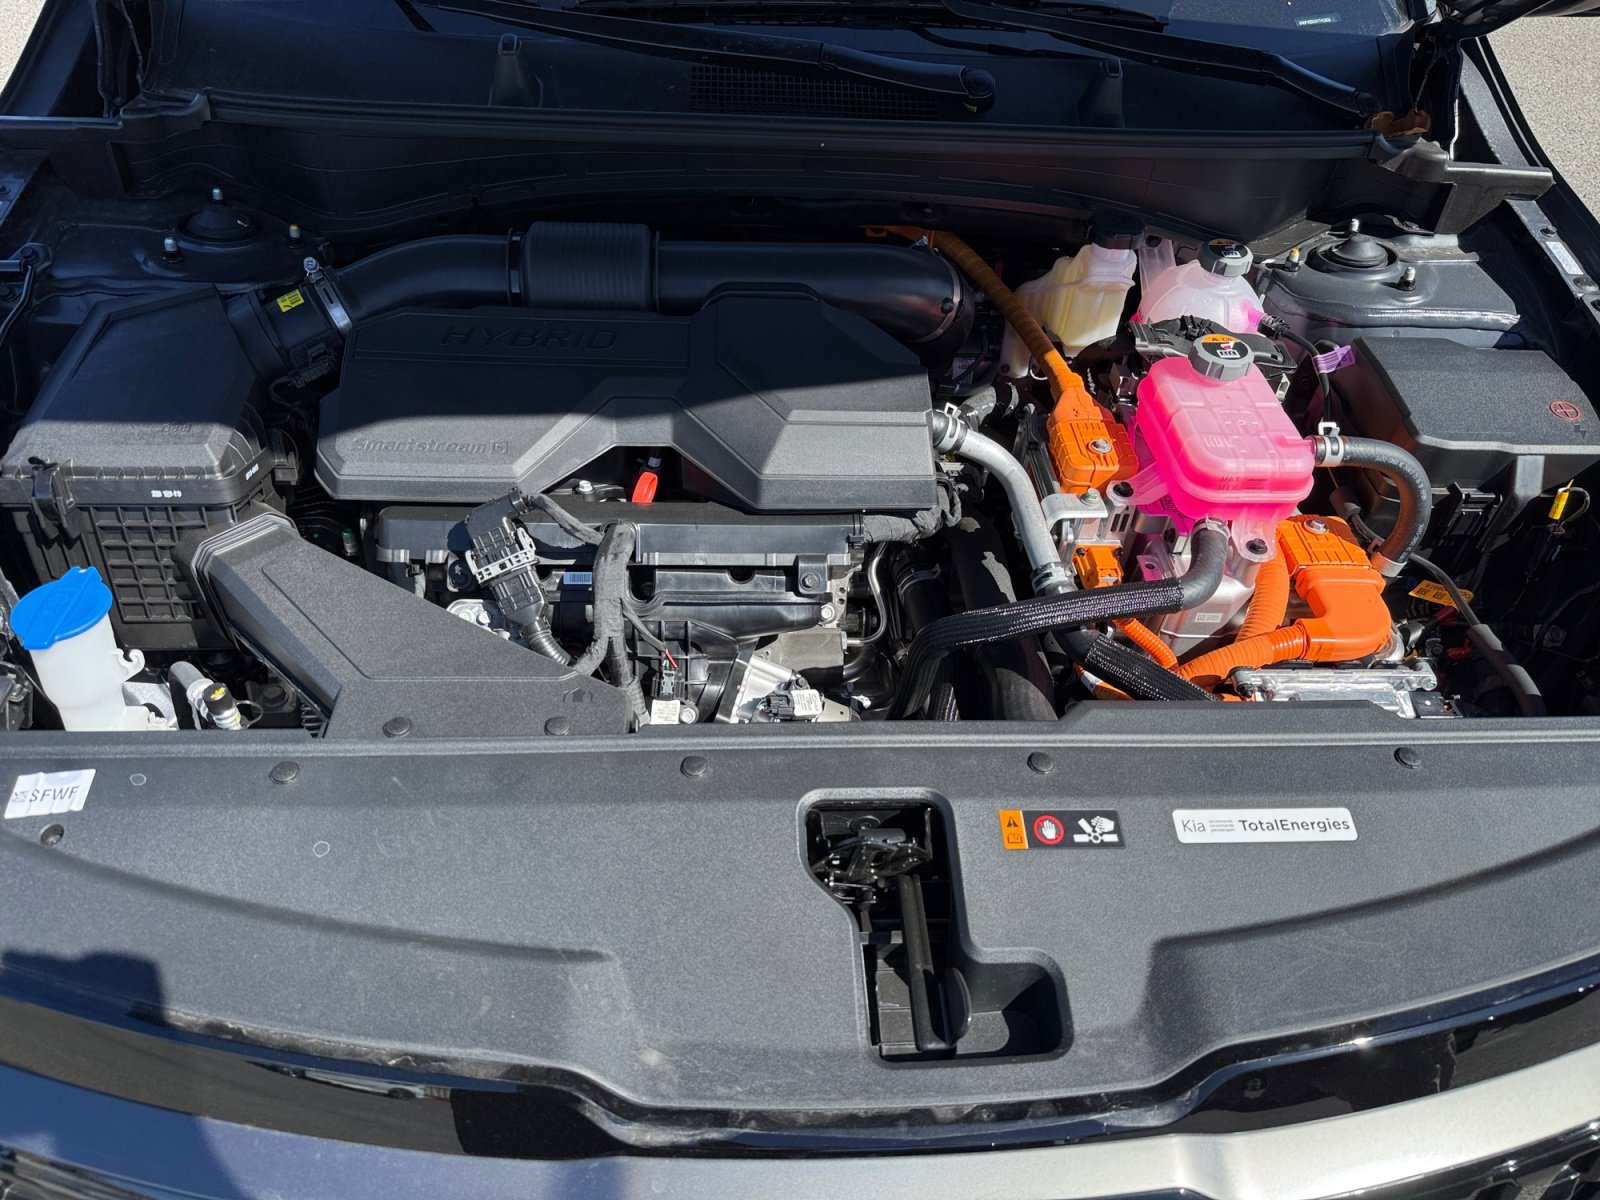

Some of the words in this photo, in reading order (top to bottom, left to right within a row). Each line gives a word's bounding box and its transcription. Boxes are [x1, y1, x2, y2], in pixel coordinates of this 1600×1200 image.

[440, 327, 617, 350] HYBRID
[352, 438, 486, 454] Smartstream
[29, 785, 80, 803] SFWF
[1181, 819, 1206, 833] Kia
[1238, 818, 1350, 833] TotalEnergies
